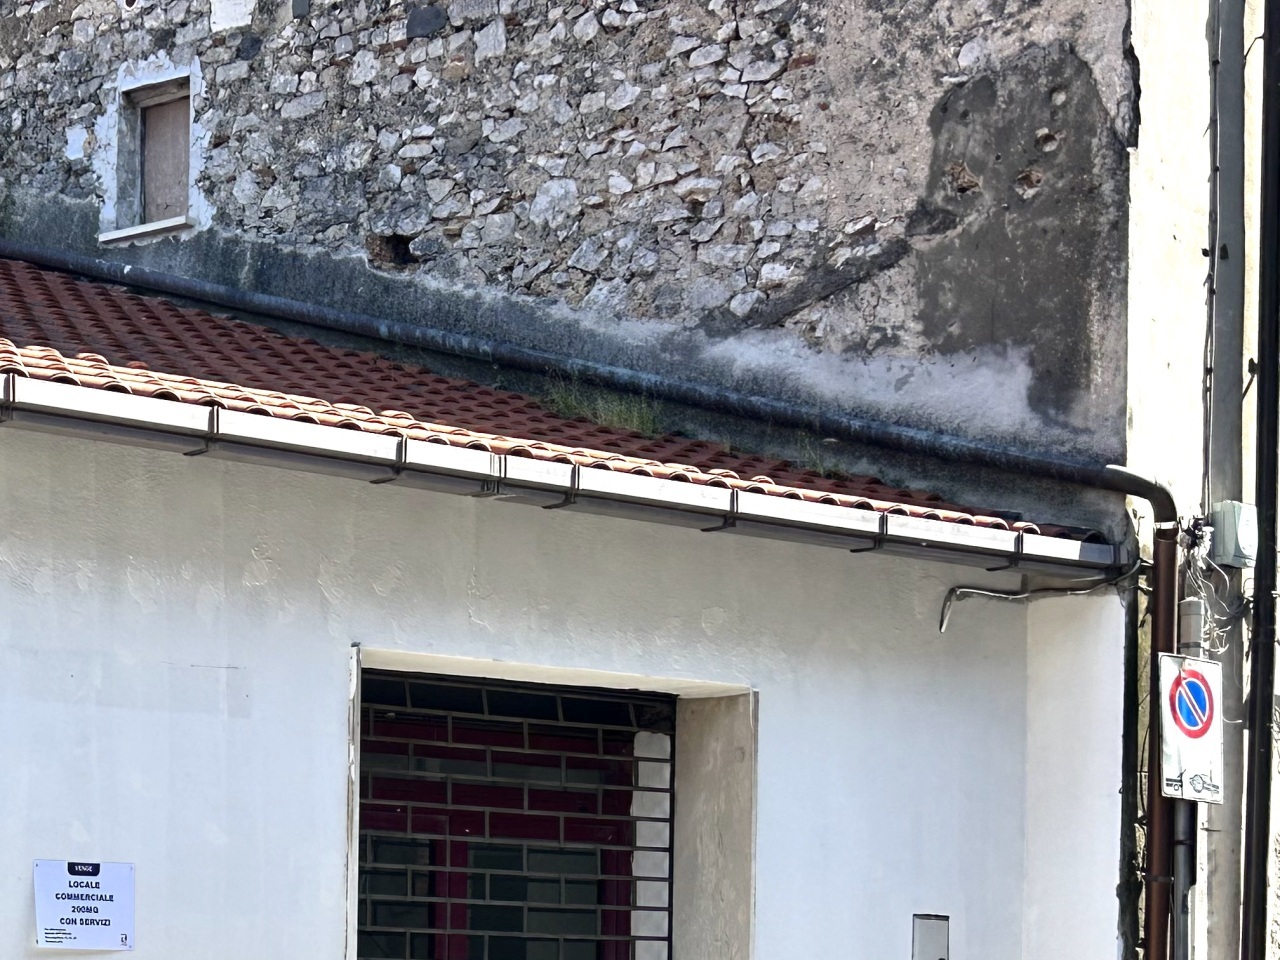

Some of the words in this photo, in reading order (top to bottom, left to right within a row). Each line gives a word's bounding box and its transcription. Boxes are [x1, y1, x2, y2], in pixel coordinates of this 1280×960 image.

[68, 880, 100, 889] LOCALE
[55, 892, 114, 902] COMMERCIALE
[59, 917, 77, 926] CON
